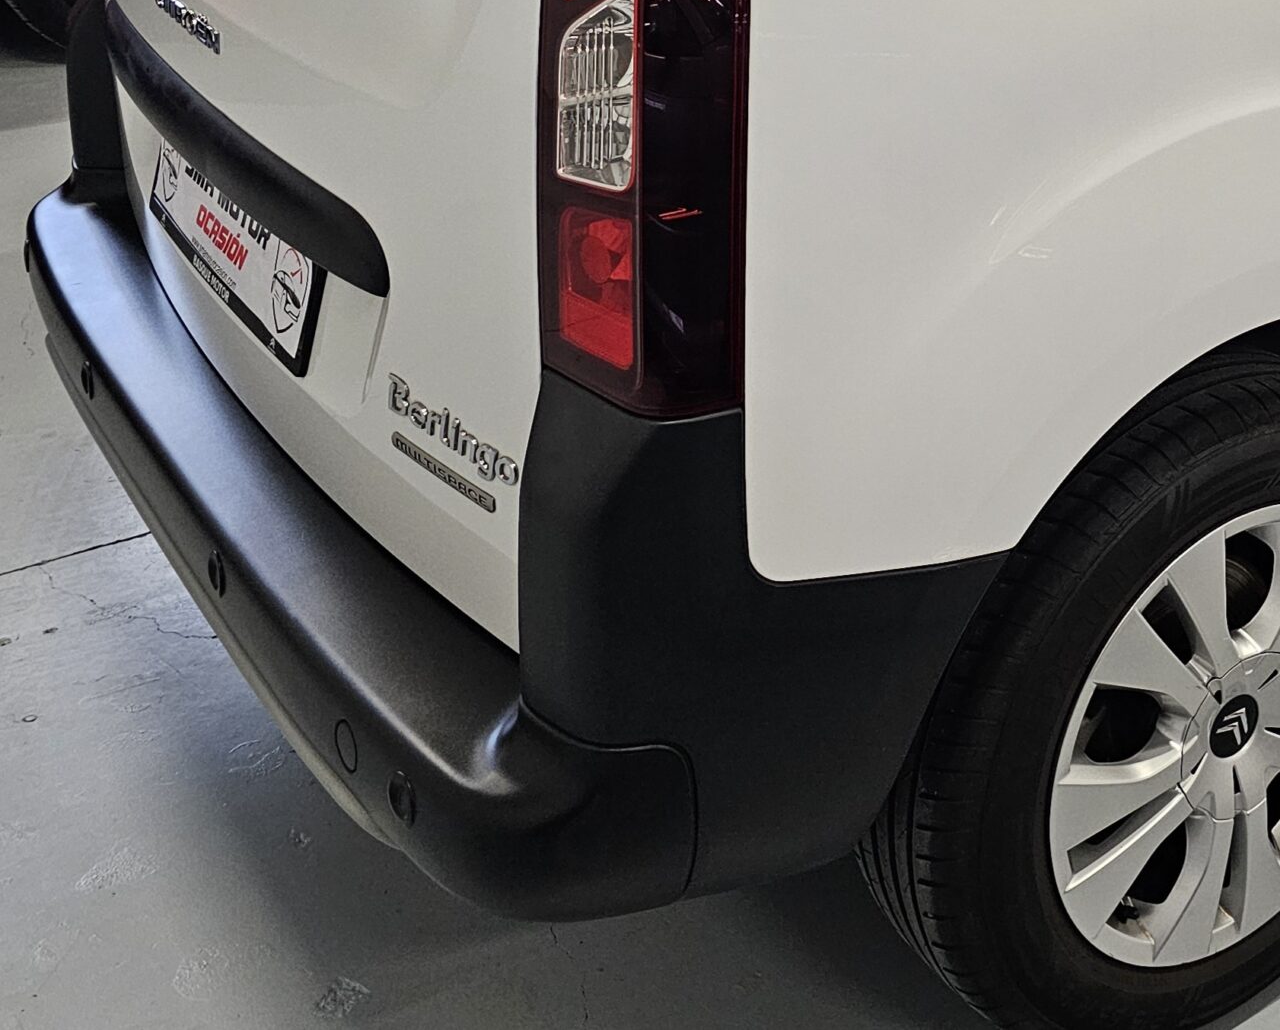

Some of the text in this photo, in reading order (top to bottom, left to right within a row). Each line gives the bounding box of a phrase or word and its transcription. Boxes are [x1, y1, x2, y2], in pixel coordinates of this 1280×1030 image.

[196, 204, 248, 270] OCASIÓN
[217, 190, 271, 251] MOTOR
[388, 372, 519, 486] Berlingo
[395, 436, 488, 508] MULTISPACE
